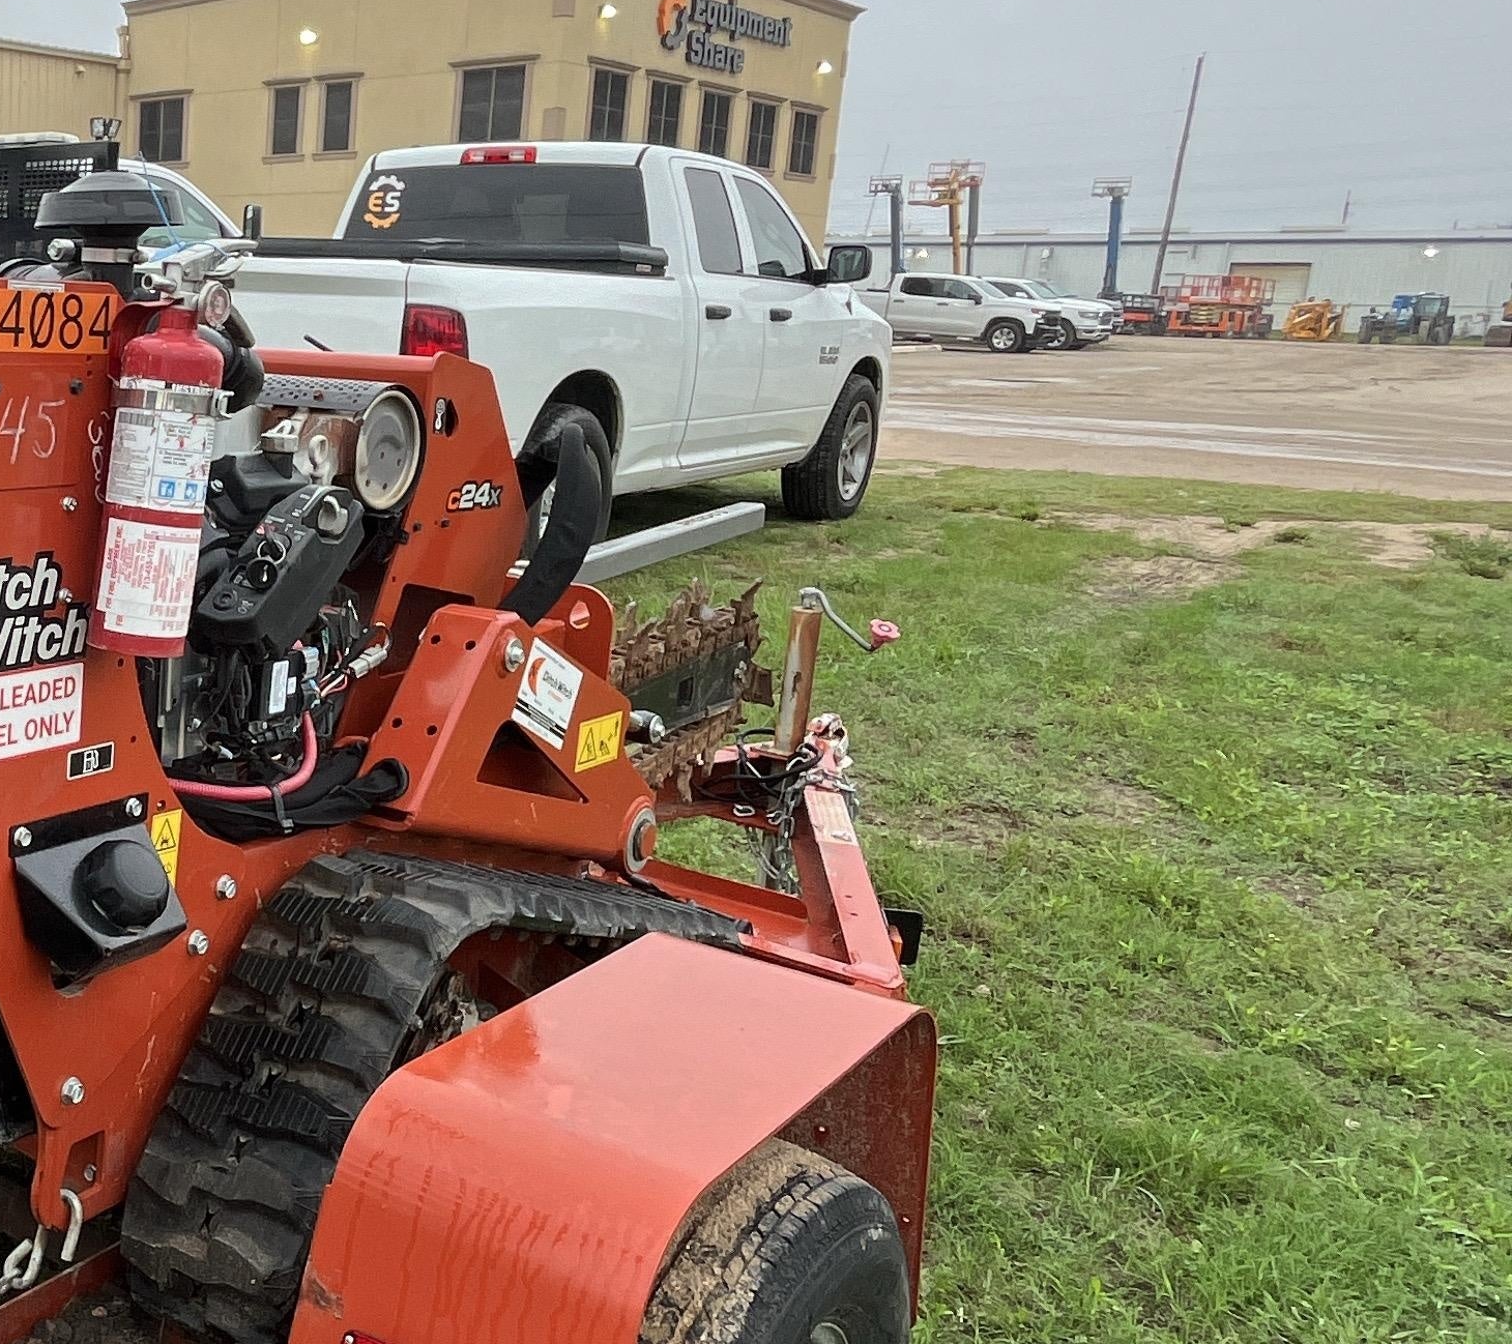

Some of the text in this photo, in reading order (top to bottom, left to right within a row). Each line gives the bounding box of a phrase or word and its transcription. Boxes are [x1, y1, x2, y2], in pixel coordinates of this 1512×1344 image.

[687, 30, 745, 74] Share
[368, 191, 401, 213] ES
[24, 710, 75, 741] ONLY
